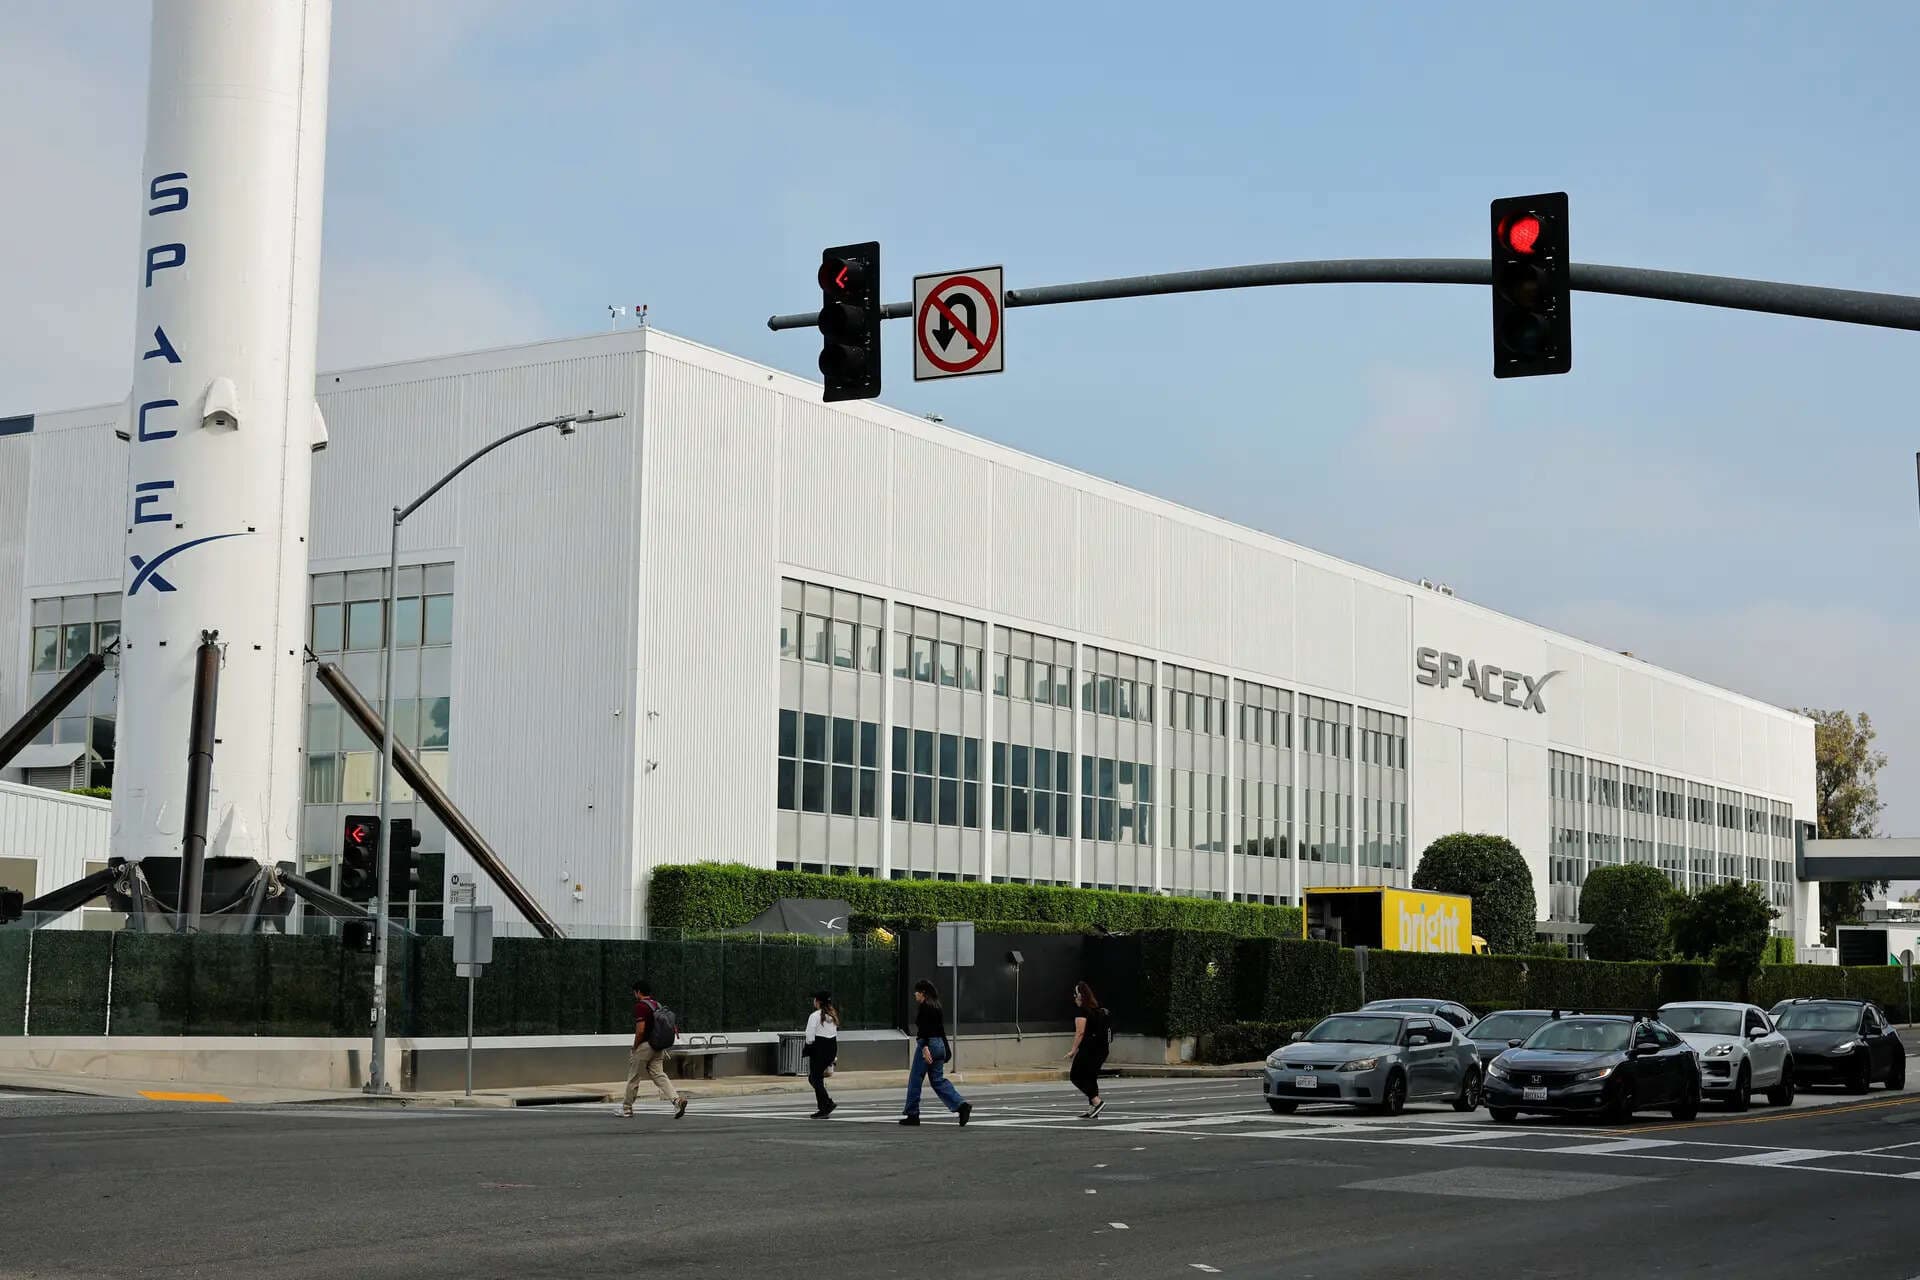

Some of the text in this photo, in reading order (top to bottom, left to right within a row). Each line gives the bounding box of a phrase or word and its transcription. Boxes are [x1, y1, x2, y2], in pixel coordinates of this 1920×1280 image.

[128, 172, 257, 596] SPACEX
[1417, 647, 1566, 713] SPACEX
[1399, 899, 1459, 953] bright
